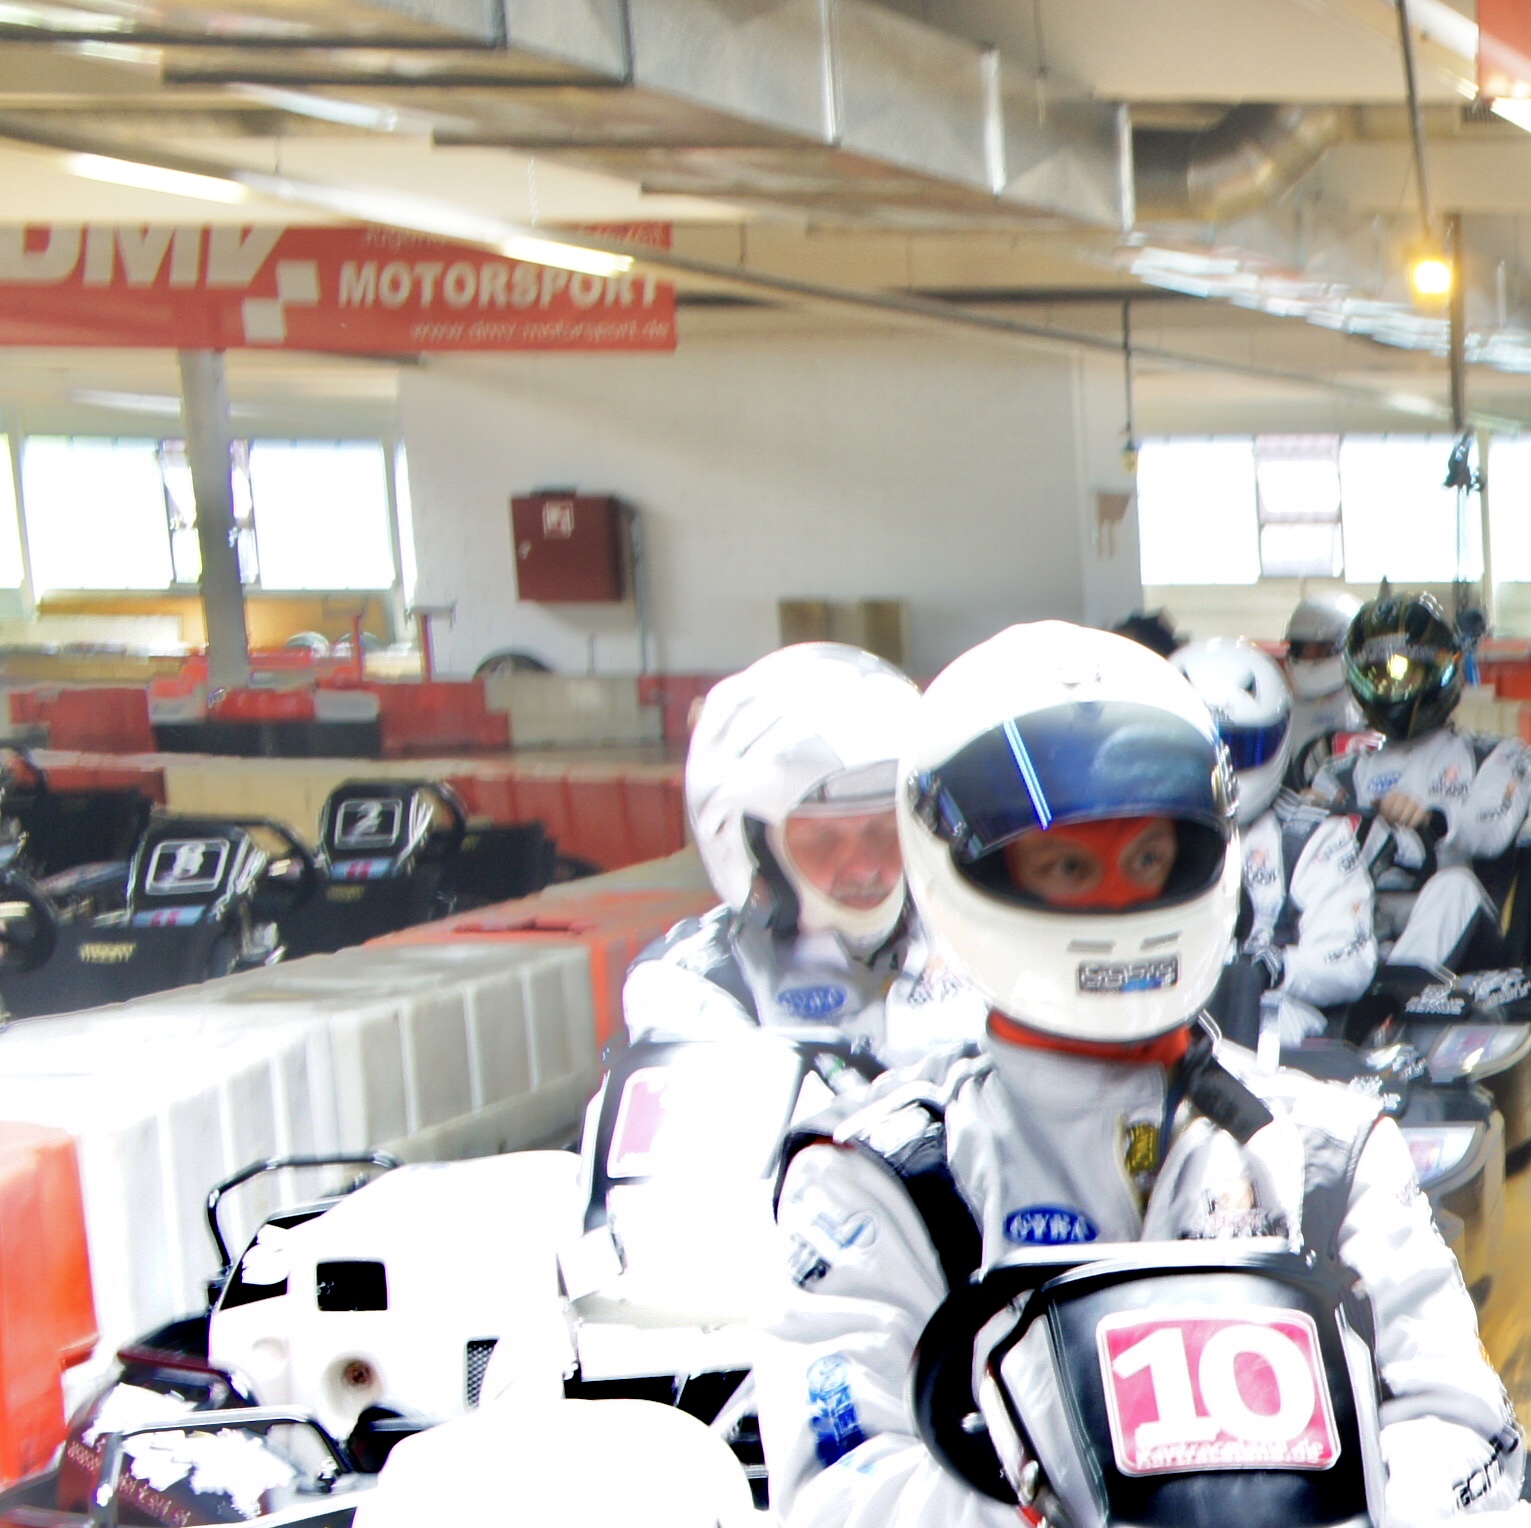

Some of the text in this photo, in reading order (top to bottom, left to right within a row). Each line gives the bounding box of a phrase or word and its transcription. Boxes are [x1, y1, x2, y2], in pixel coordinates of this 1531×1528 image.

[337, 259, 660, 310] MOTORSPORT
[410, 318, 669, 344] www.dmv-motorsport.de
[1112, 1323, 1316, 1444] 10
